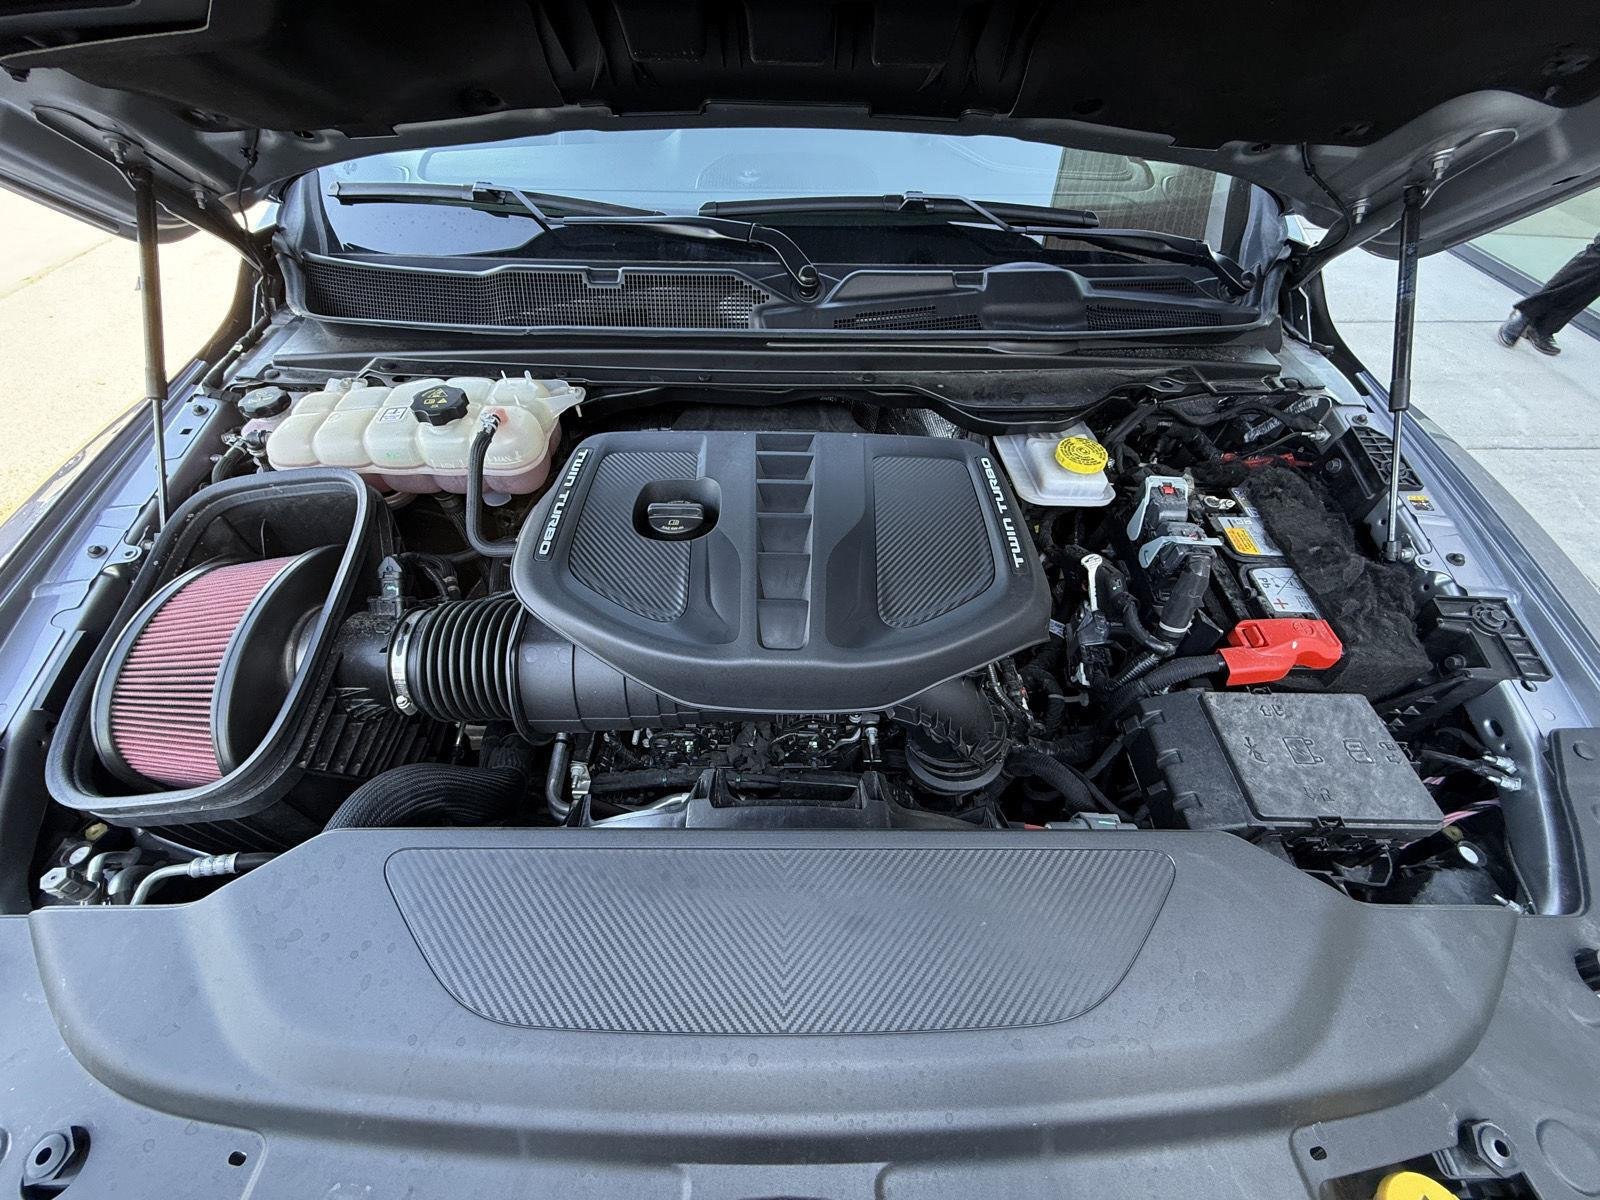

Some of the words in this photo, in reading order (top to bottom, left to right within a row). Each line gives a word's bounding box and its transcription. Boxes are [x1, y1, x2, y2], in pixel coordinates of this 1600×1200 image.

[563, 449, 588, 487] TWIN
[980, 457, 1008, 514] TURBO
[538, 490, 570, 555] TURBO
[1002, 517, 1025, 568] TWIN
[1258, 577, 1272, 589] Pb
